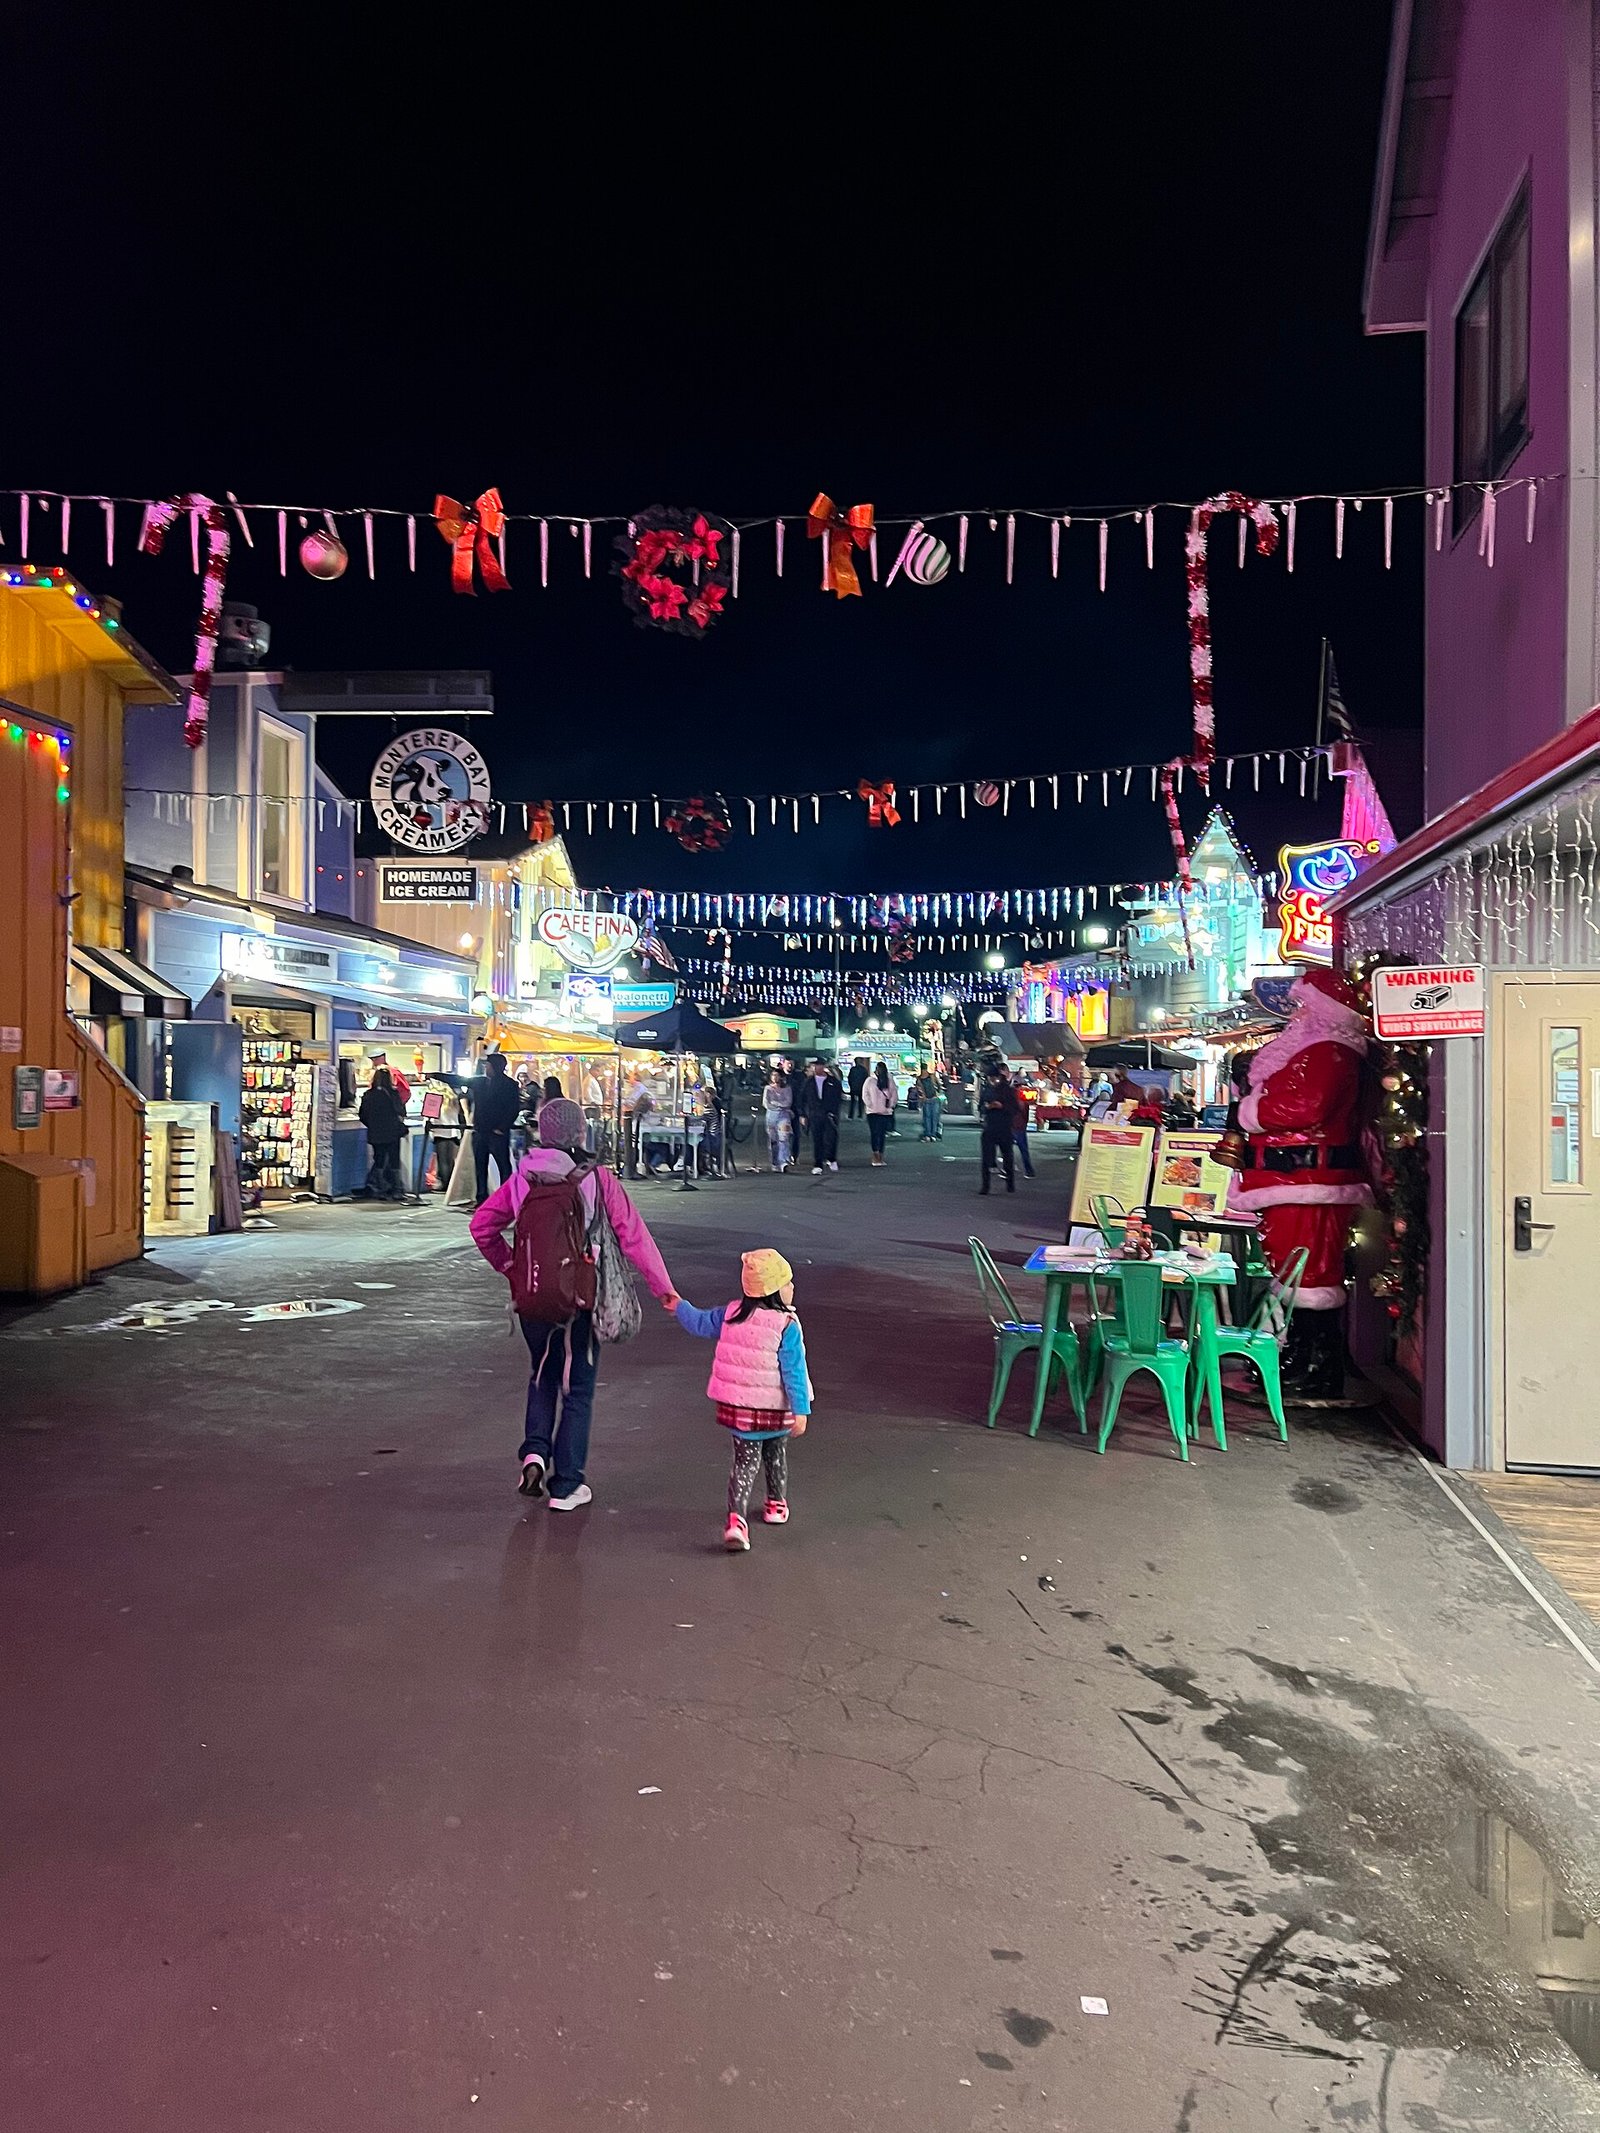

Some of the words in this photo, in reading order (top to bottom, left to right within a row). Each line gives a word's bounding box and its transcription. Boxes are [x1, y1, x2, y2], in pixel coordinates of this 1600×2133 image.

[375, 731, 463, 789] MONTEREY
[462, 751, 488, 790] BAY
[380, 806, 480, 848] CREAMERY
[387, 870, 472, 883] HOMEMADE
[389, 885, 414, 897] ICE
[418, 885, 470, 897] CREAM
[544, 913, 590, 940] CAFE
[595, 916, 633, 942] FINA
[1385, 969, 1475, 986] WARNING
[1383, 1021, 1412, 1033] VIDEO
[1413, 1018, 1484, 1032] SURVEILLANCE
